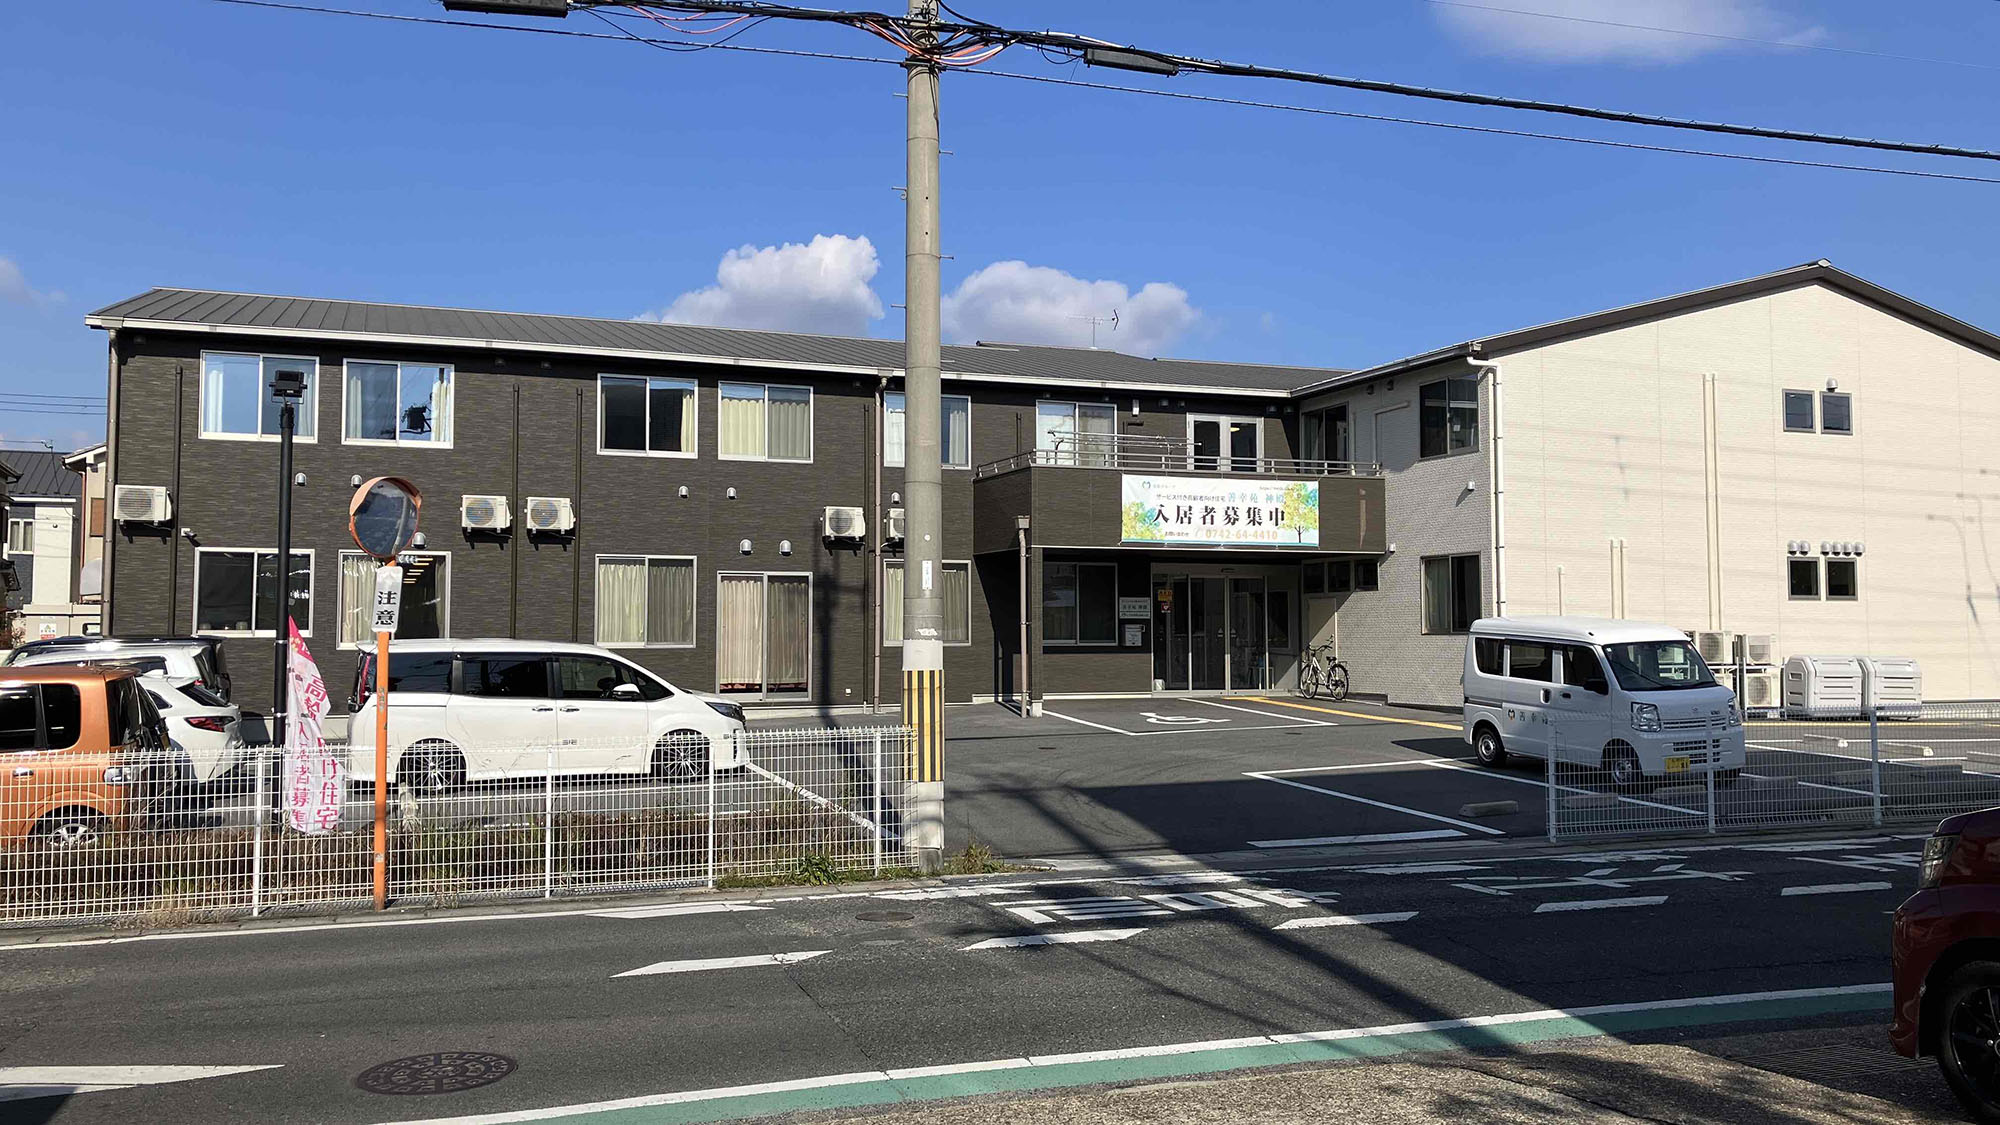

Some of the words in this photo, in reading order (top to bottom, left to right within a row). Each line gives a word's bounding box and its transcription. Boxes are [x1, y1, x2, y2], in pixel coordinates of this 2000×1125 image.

[1153, 504, 1285, 527] 入居者募集中
[1205, 528, 1278, 540] 0742-64-4410
[375, 590, 398, 626] 注意
